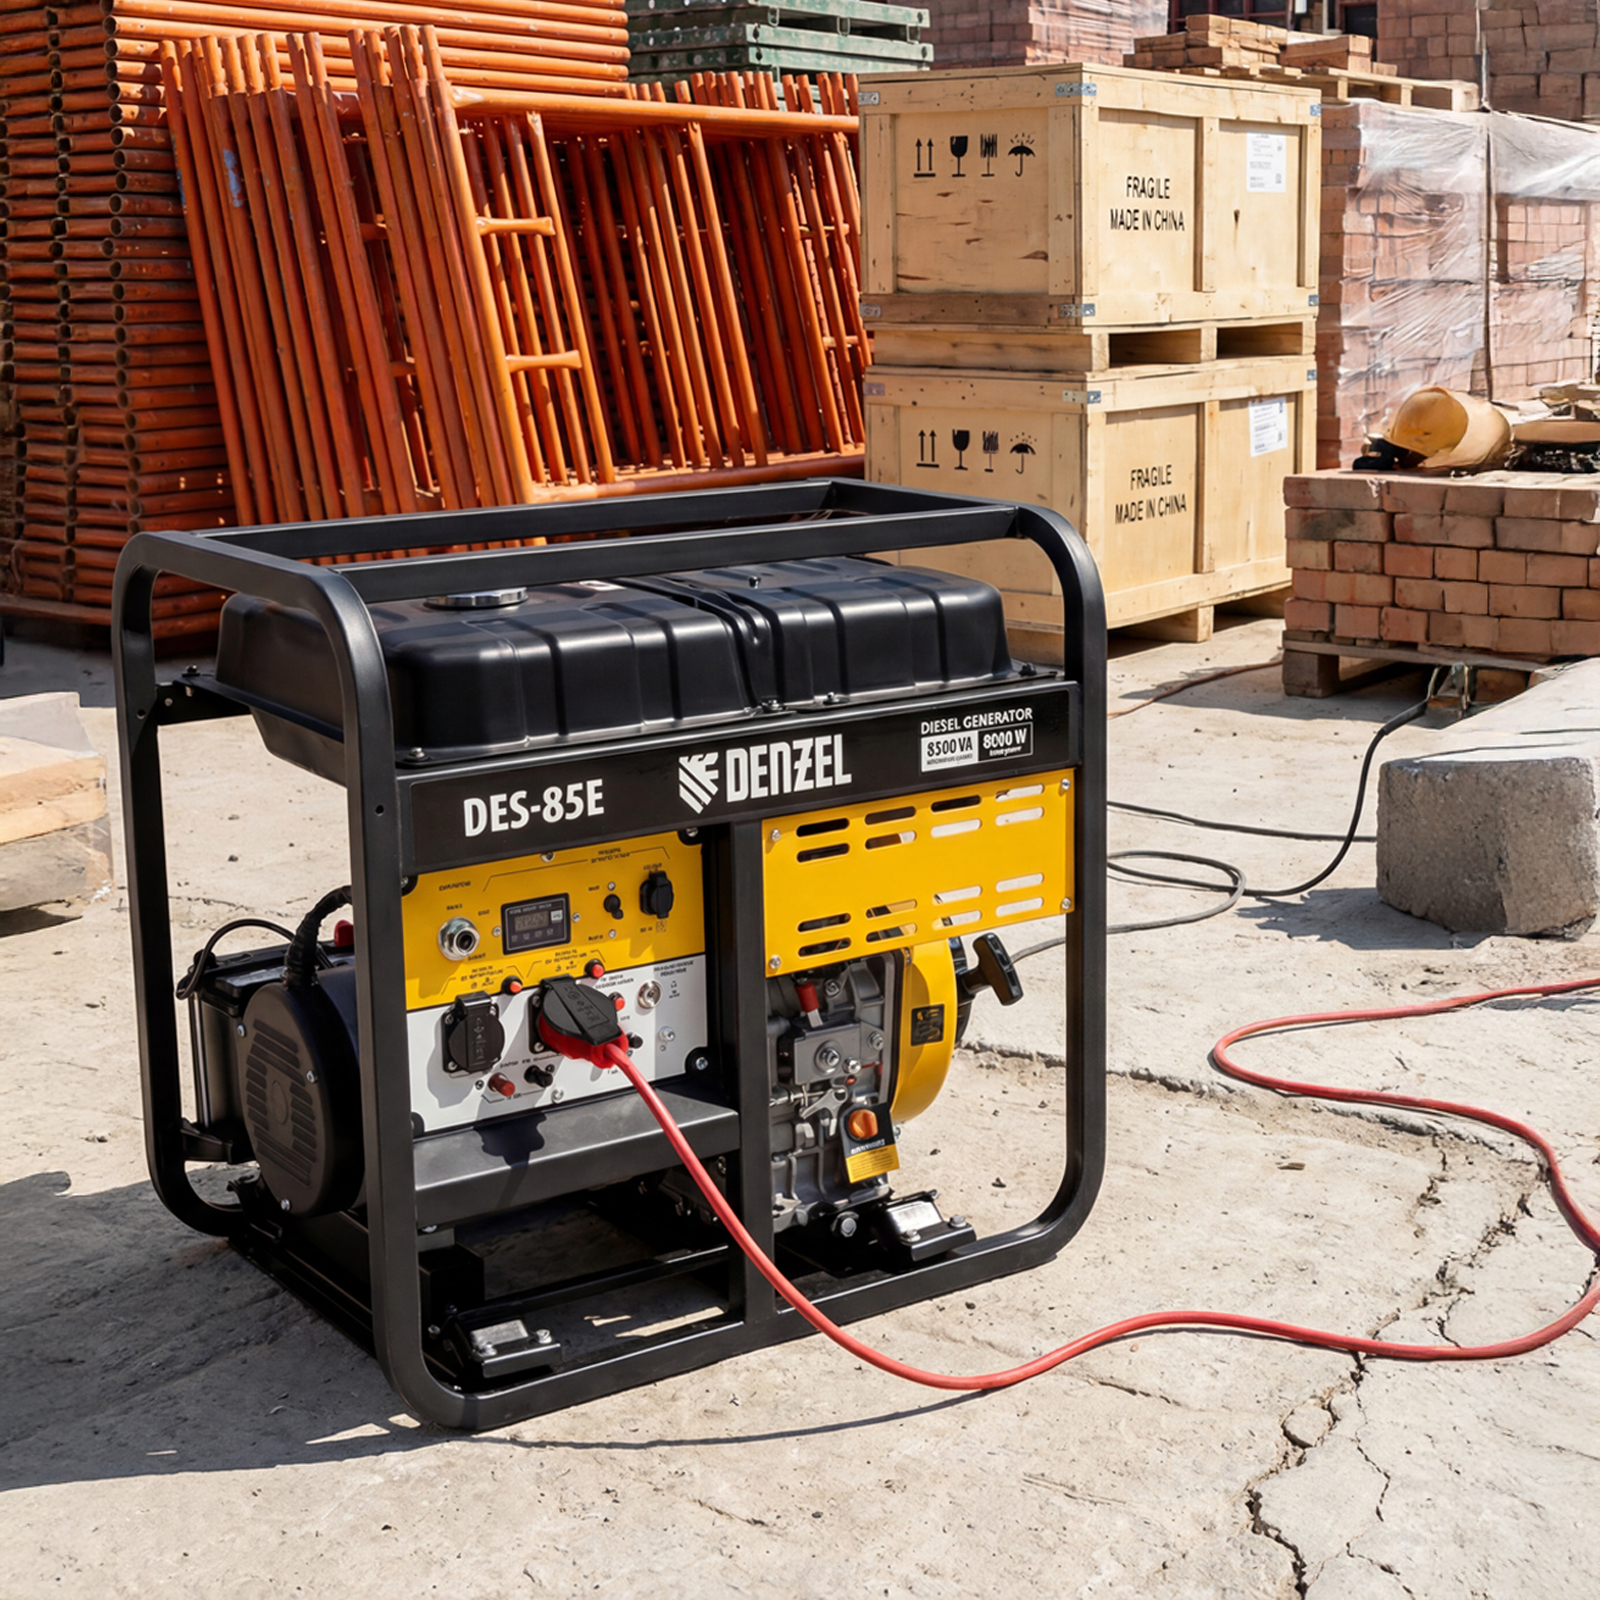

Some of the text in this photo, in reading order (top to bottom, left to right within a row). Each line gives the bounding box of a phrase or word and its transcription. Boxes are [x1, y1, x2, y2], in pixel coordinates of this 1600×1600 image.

[1126, 176, 1170, 199] FRAGILE
[1110, 209, 1185, 231] MADE IN CHINA
[1131, 464, 1172, 491] FRAGILE
[1115, 493, 1187, 525] MADE IN CHINA
[921, 707, 1033, 735] DIESEL GENERATOR
[927, 738, 957, 757] 8500
[958, 736, 973, 752] VA
[983, 728, 1027, 749] 8000 W
[726, 733, 852, 803] DENZEL
[463, 778, 605, 837] DES-85E
